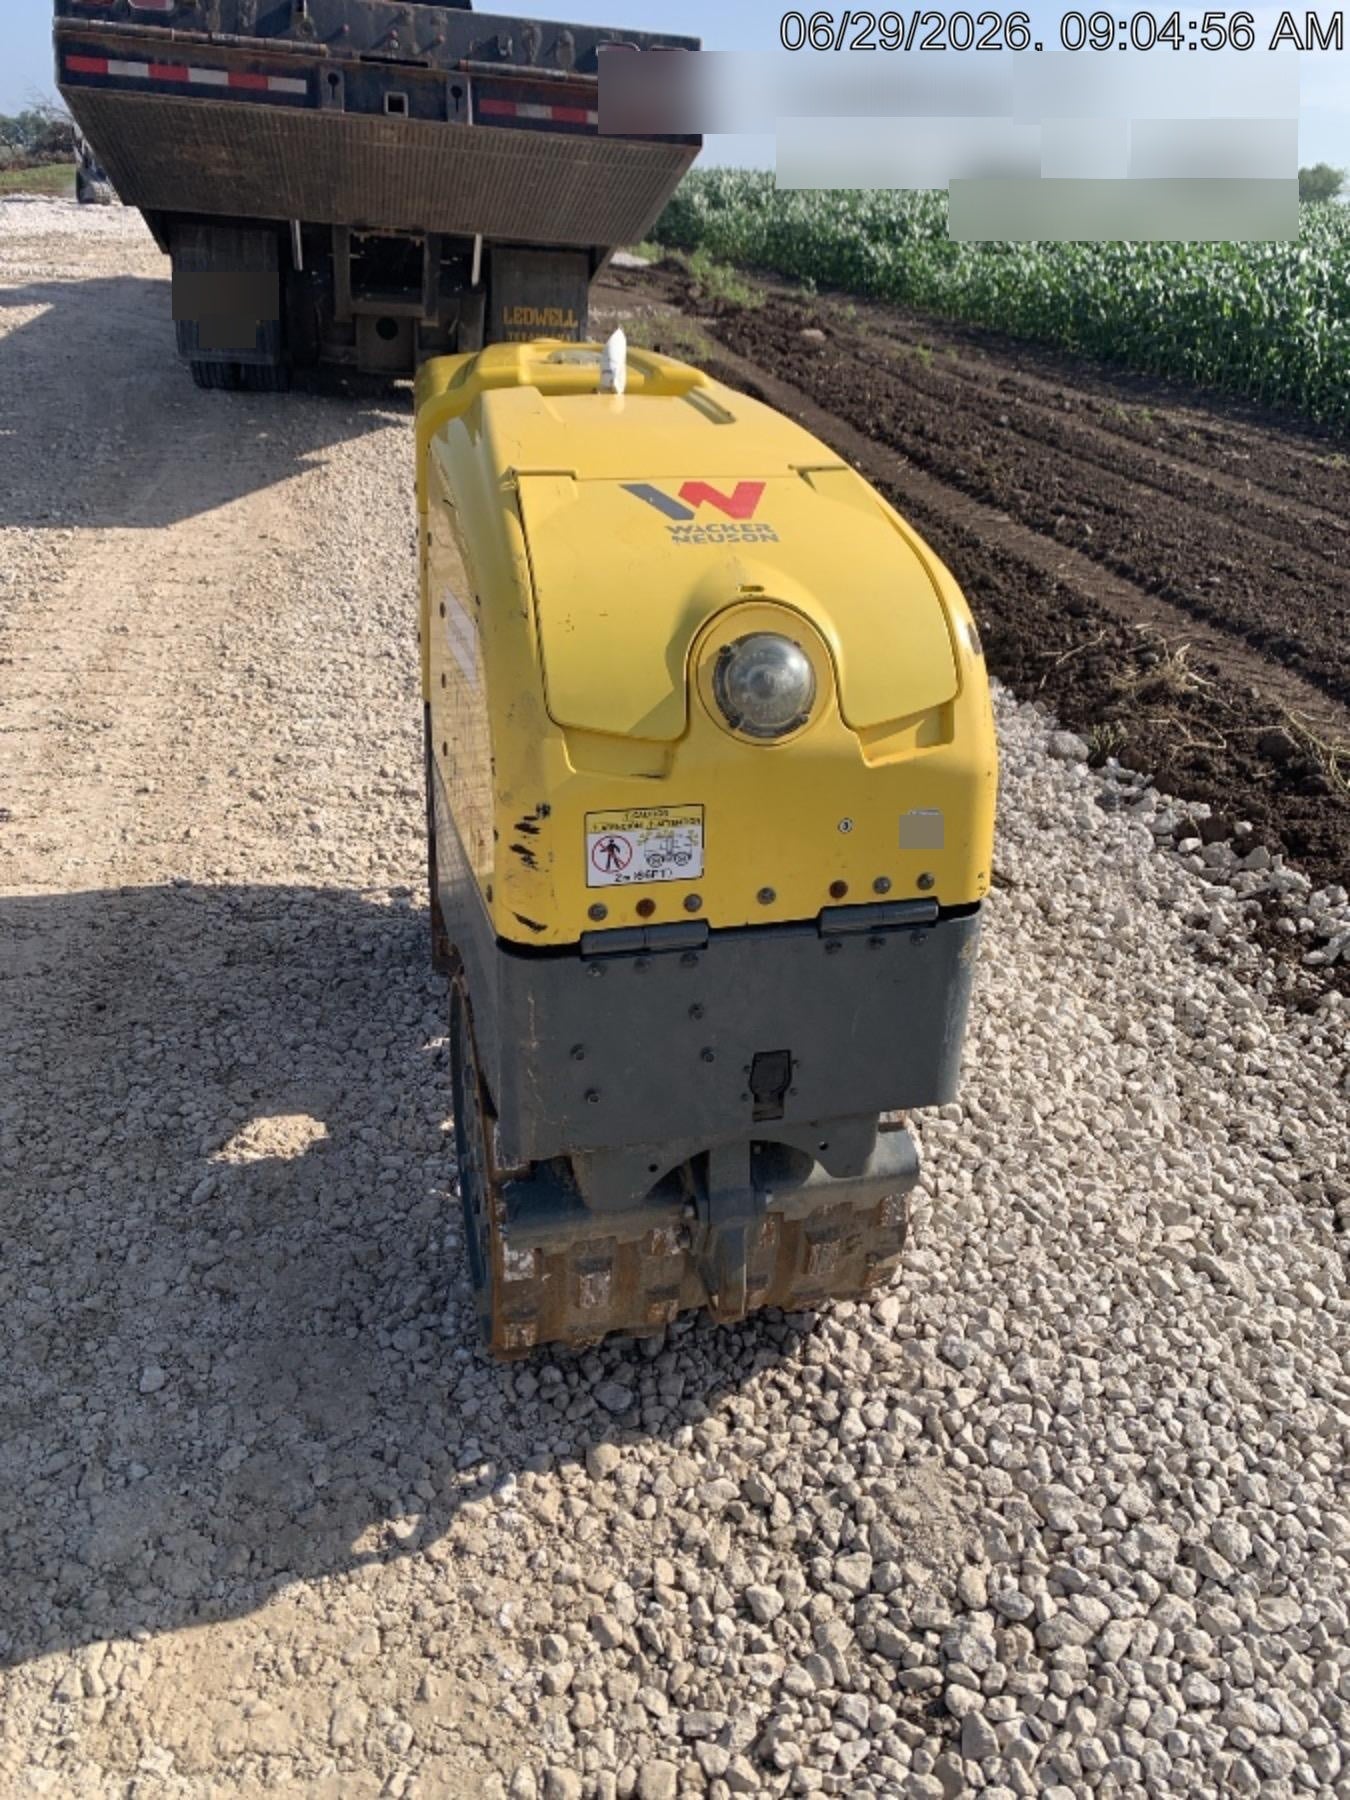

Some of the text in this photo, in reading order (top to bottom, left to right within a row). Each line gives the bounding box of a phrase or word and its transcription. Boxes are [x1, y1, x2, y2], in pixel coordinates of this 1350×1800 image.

[503, 306, 578, 328] LEDWELL
[664, 523, 774, 534] WACKER
[671, 533, 780, 543] NEUSON
